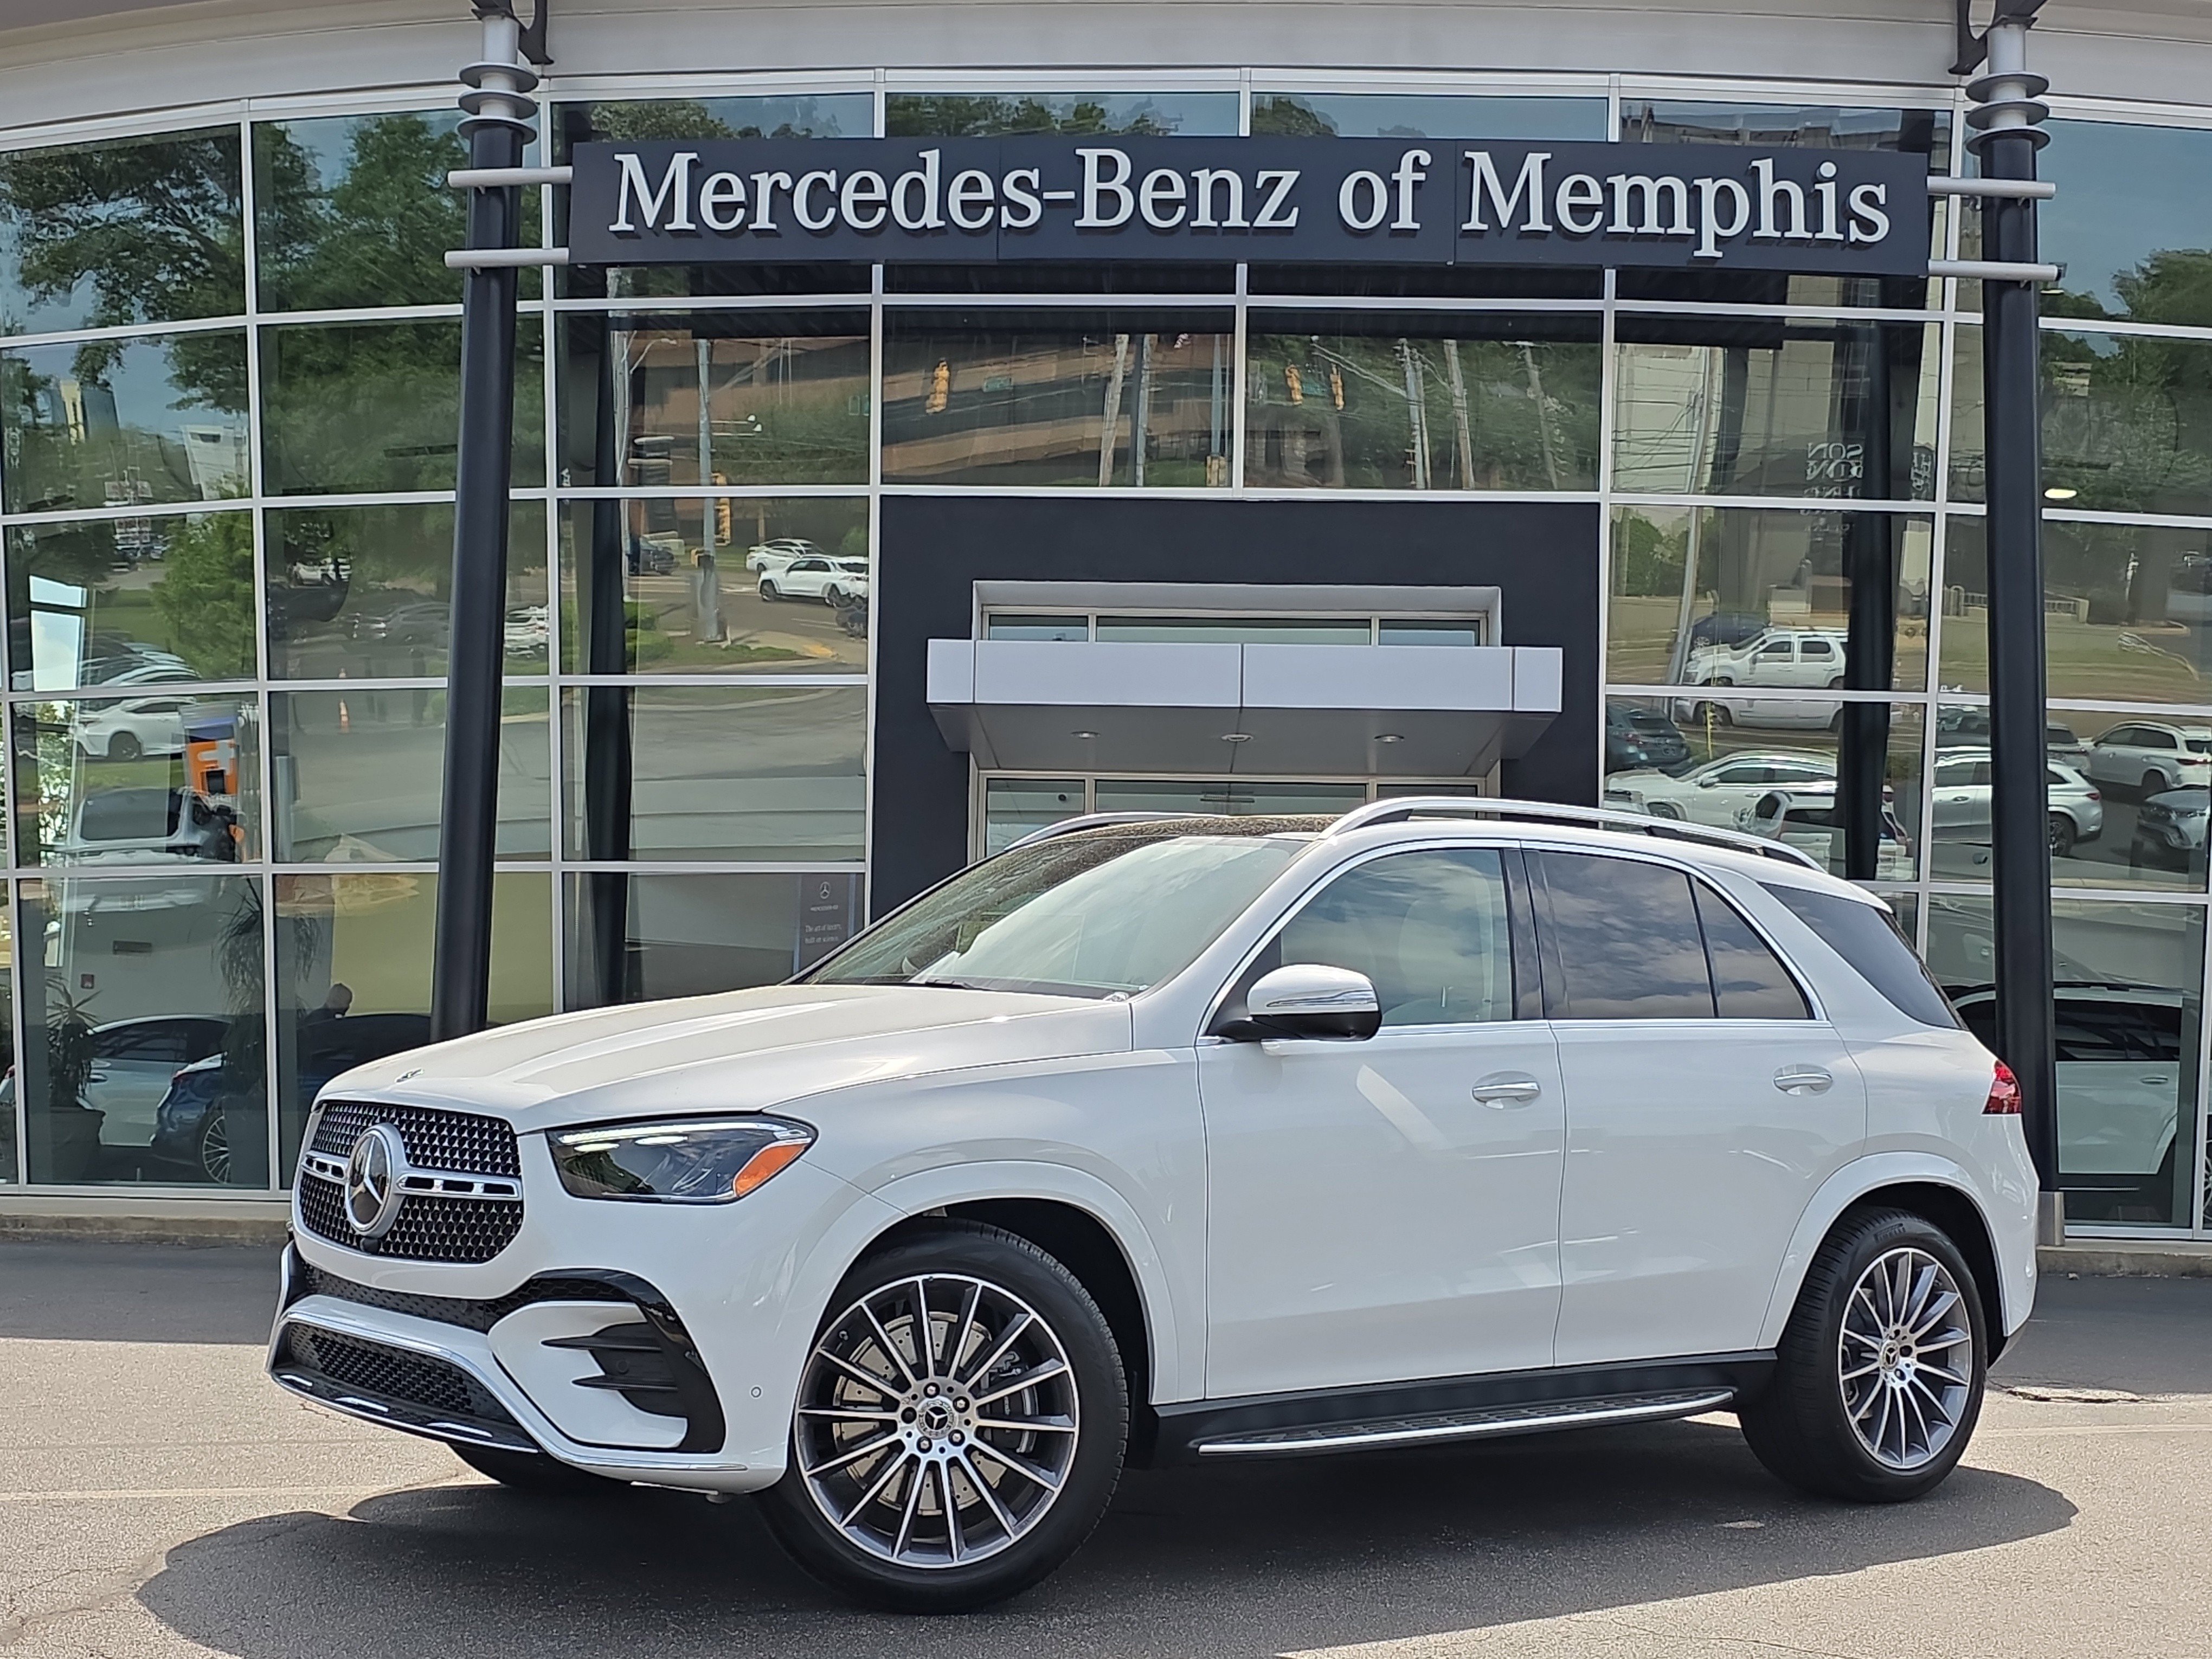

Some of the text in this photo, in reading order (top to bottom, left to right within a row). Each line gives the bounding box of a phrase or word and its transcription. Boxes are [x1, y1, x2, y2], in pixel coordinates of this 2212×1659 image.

[608, 148, 1891, 259] Mercedes-Benz of Memphis
